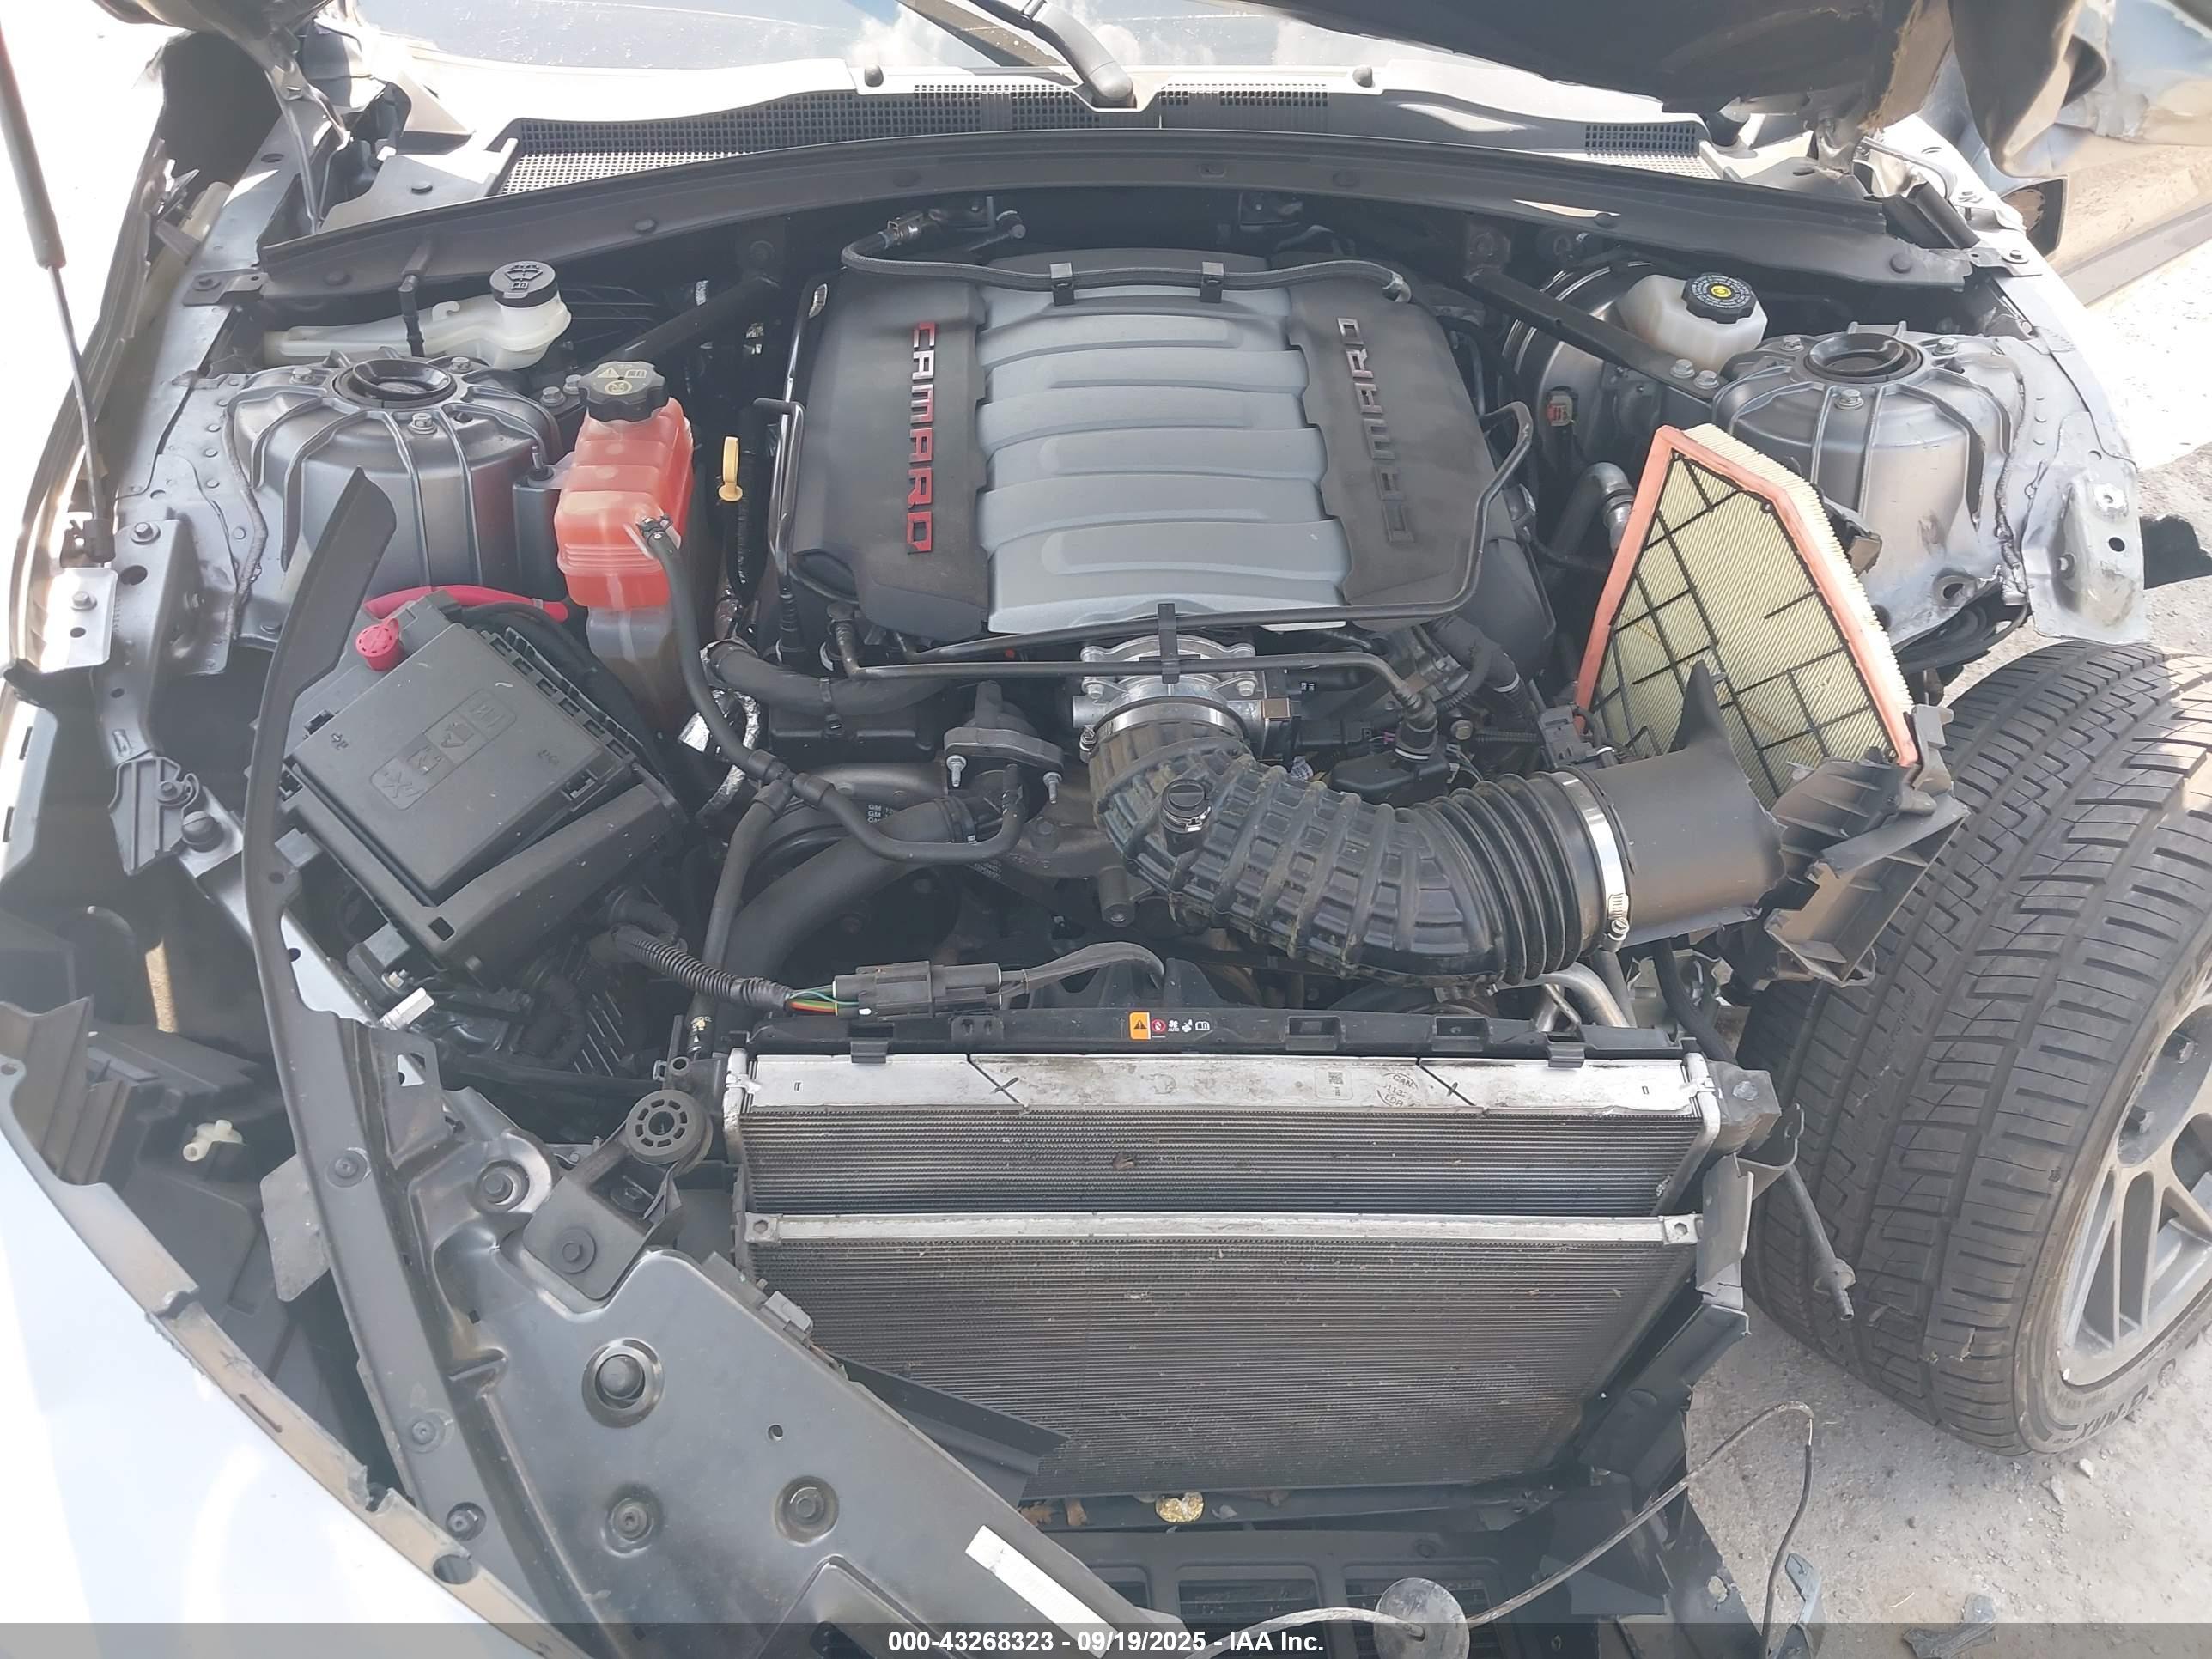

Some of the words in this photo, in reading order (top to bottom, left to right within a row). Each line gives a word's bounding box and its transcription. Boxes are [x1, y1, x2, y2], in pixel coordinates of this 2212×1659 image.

[907, 321, 936, 555] CAMARO
[1336, 317, 1415, 543] CAMARO
[1393, 1073, 1413, 1088] CAN
